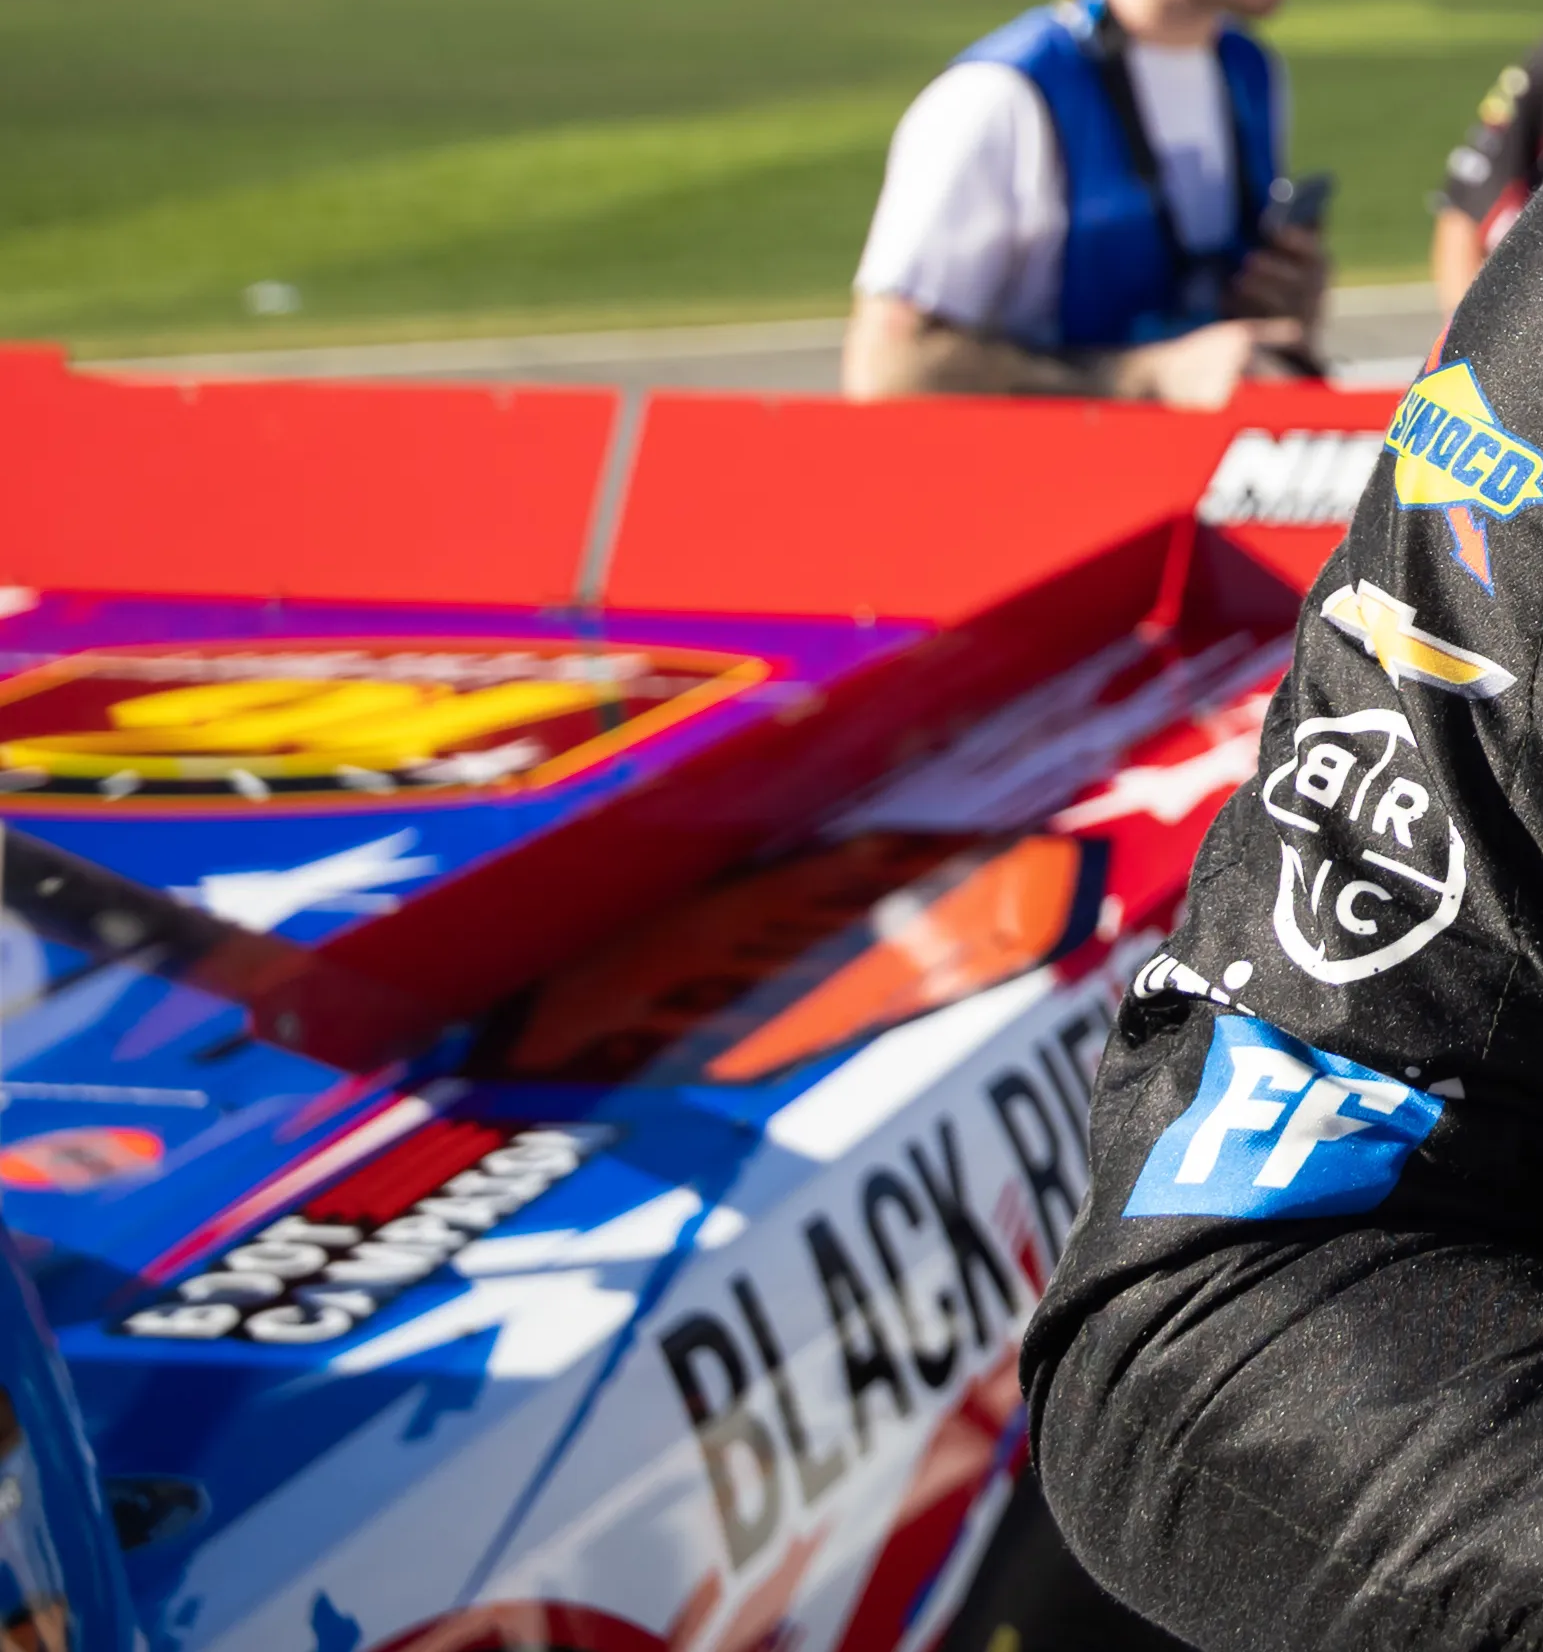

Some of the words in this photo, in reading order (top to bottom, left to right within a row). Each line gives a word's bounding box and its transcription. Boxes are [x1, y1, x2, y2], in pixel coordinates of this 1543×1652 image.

[655, 1110, 1022, 1575] BLACK
[982, 998, 1110, 1261] RIF
[1174, 1045, 1411, 1188] FF
